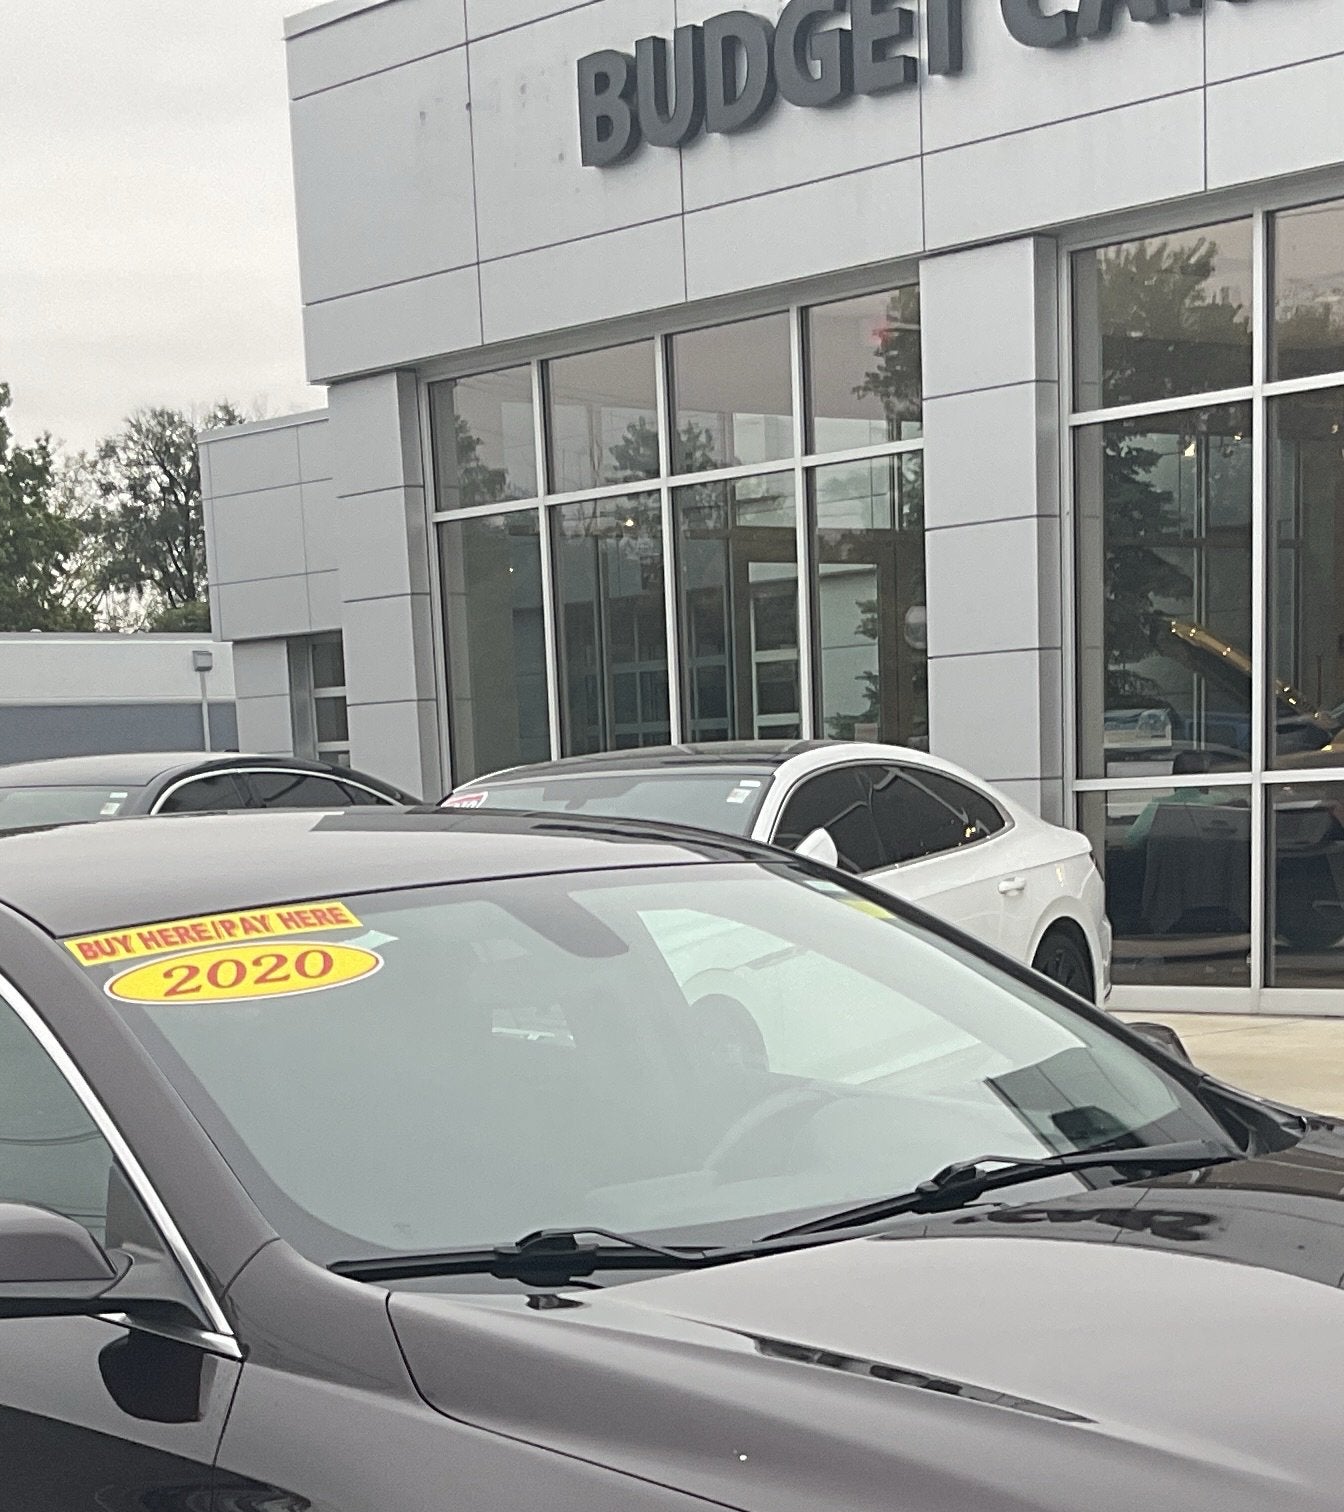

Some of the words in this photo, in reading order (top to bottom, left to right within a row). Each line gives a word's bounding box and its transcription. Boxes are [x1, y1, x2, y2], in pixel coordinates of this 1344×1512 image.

[75, 934, 133, 961] BUY
[136, 914, 275, 952] HERE/PAY
[276, 906, 354, 932] HERE
[162, 949, 334, 997] 2020
